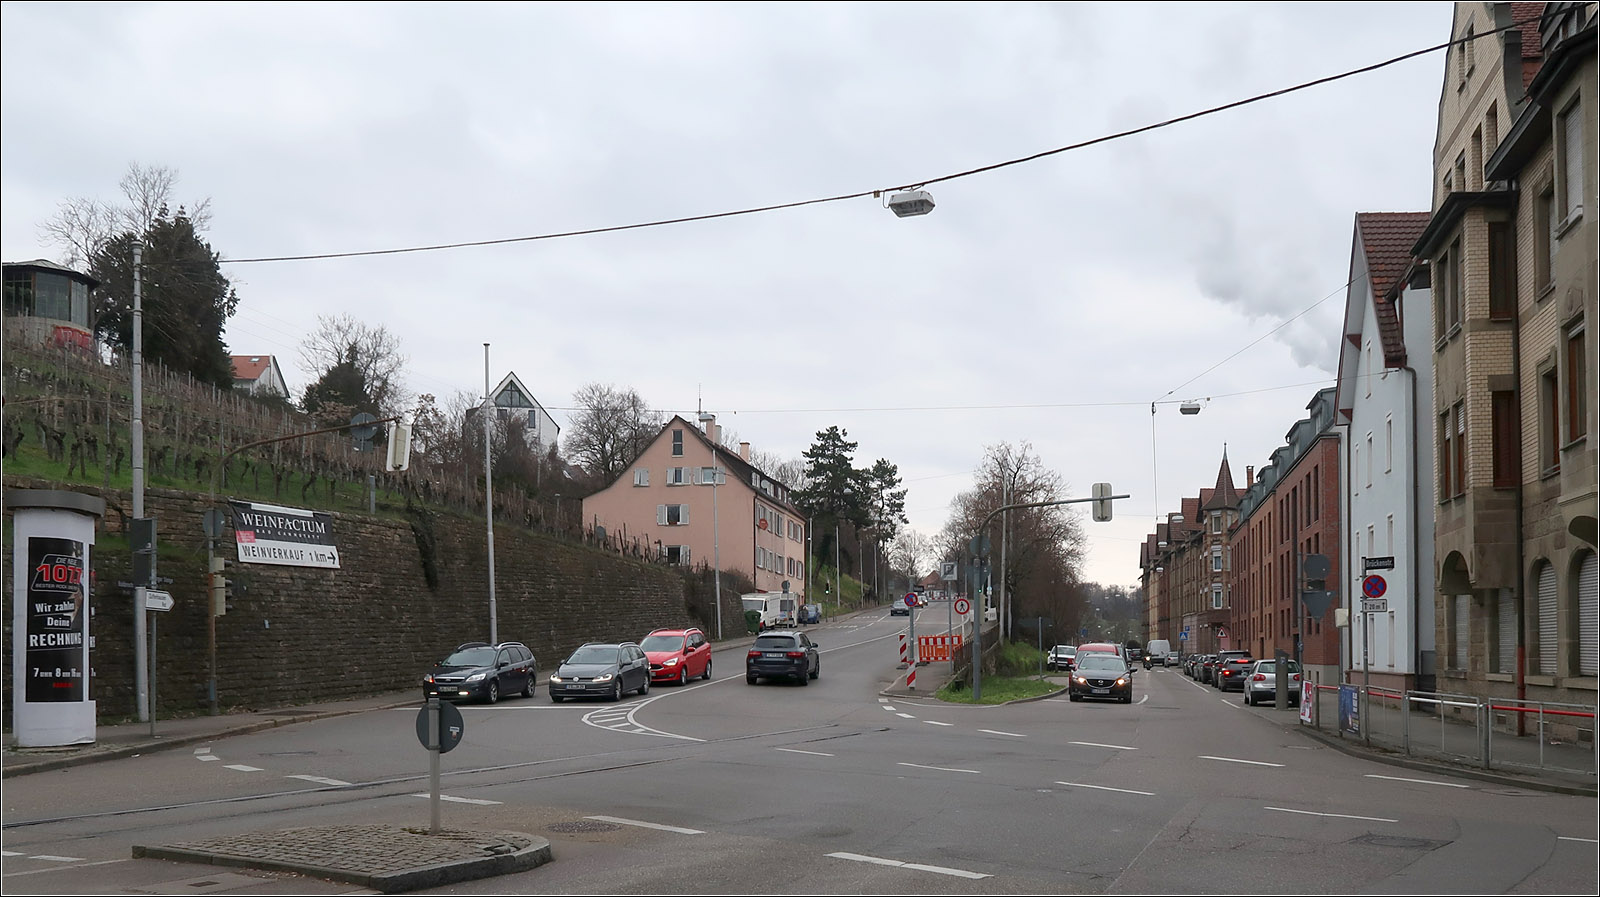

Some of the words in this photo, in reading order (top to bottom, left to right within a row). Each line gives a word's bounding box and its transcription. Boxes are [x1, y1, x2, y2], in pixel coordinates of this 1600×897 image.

[241, 512, 326, 534] WEINFACTUM
[242, 545, 304, 560] WEINVERKAUF
[309, 552, 314, 562] 1
[35, 602, 52, 613] Wir
[47, 616, 70, 627] Deine
[29, 632, 82, 647] RECHNUNG
